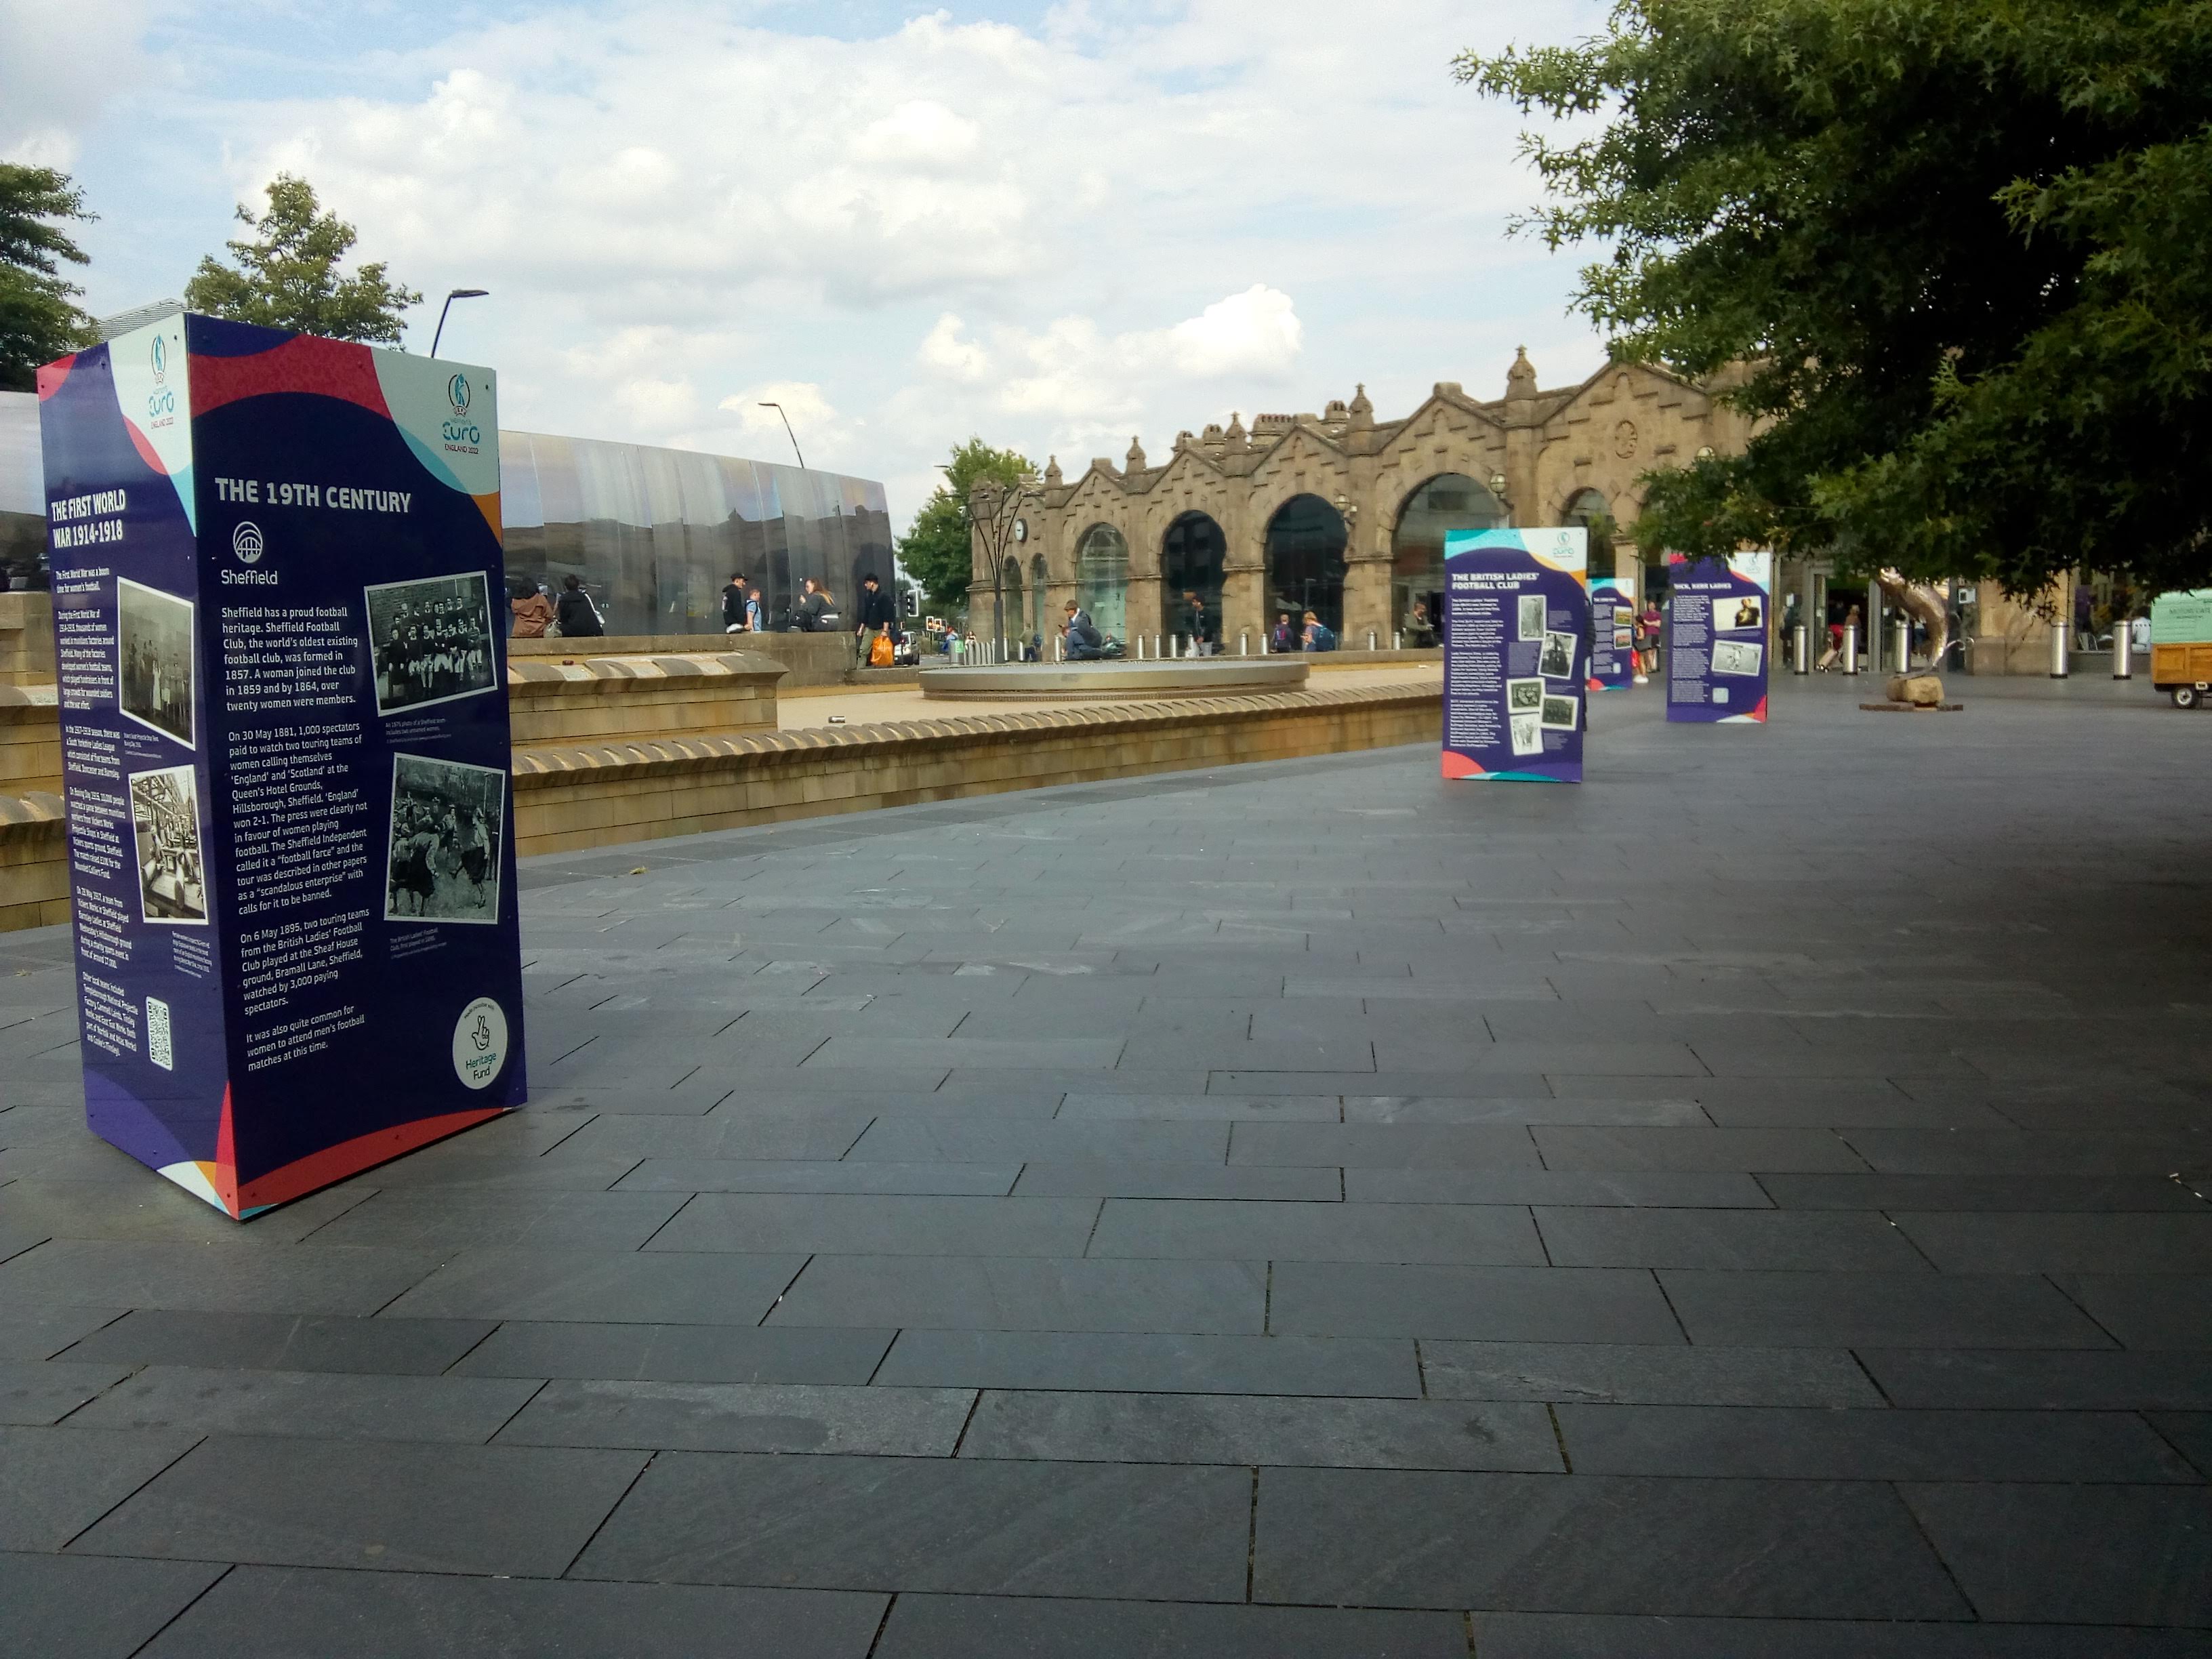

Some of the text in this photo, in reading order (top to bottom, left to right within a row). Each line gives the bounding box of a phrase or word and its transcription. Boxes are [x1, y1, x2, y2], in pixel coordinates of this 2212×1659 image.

[52, 489, 126, 521] THE FIRST WORLD
[215, 477, 411, 513] THE 19TH CENTURY
[53, 519, 123, 548] WAR 1914-1918
[222, 570, 278, 585] Sheffield
[1452, 581, 1495, 590] FOOTBALL
[222, 608, 262, 617] Sheffield
[265, 607, 279, 617] has
[289, 607, 314, 619] proud
[316, 607, 348, 617] football
[222, 622, 340, 634] heritage. Sheffield Football
[224, 636, 357, 649] Club, the world's oldest existing
[224, 653, 260, 664] football
[262, 653, 283, 663] club,
[304, 651, 332, 661] formed
[335, 651, 343, 660] in
[226, 670, 252, 680] 1857.
[254, 669, 261, 678] A
[295, 667, 321, 678] joined
[324, 666, 337, 676] the
[339, 665, 356, 674] club
[226, 686, 234, 695] in
[238, 684, 261, 694] 1859
[264, 684, 279, 693] and
[282, 684, 292, 695] by
[295, 682, 319, 692] 1864,
[226, 695, 356, 712] twenty women were members.
[228, 732, 240, 741] On
[243, 731, 253, 739] 30
[255, 730, 272, 741] May
[299, 726, 320, 735] 1,000
[322, 723, 359, 734] spectators
[230, 735, 363, 758] paid to watch two touring teams of
[230, 753, 332, 770] women calling themselves
[231, 764, 348, 786] 'England' and 'Scotland' at the
[232, 781, 323, 801] Queen's Hotel Grounds,
[233, 789, 359, 814] Hillsborough, Sheffield. 'England'
[233, 802, 367, 828] won 2-1. The press were clearly not
[234, 819, 339, 843] in favour of women playing
[235, 829, 367, 857] football. The Sheffield Independent
[237, 859, 260, 872] called
[262, 857, 268, 867] it
[278, 850, 311, 863] "football
[312, 846, 334, 859] farce"
[337, 845, 350, 855] and
[352, 842, 363, 851] the
[237, 856, 367, 886] tour was described in other papers
[238, 892, 247, 901] as
[257, 880, 303, 897] "scandalous
[305, 872, 346, 888] enterprise"
[348, 869, 363, 879] with
[239, 889, 331, 915] calls for it to be banned.
[247, 1005, 354, 1043] It was also quite common for
[247, 1015, 365, 1057] women to attend men's football
[248, 1040, 328, 1071] matches at this time.
[466, 1053, 496, 1069] Heritage
[474, 1065, 489, 1080] Fund
